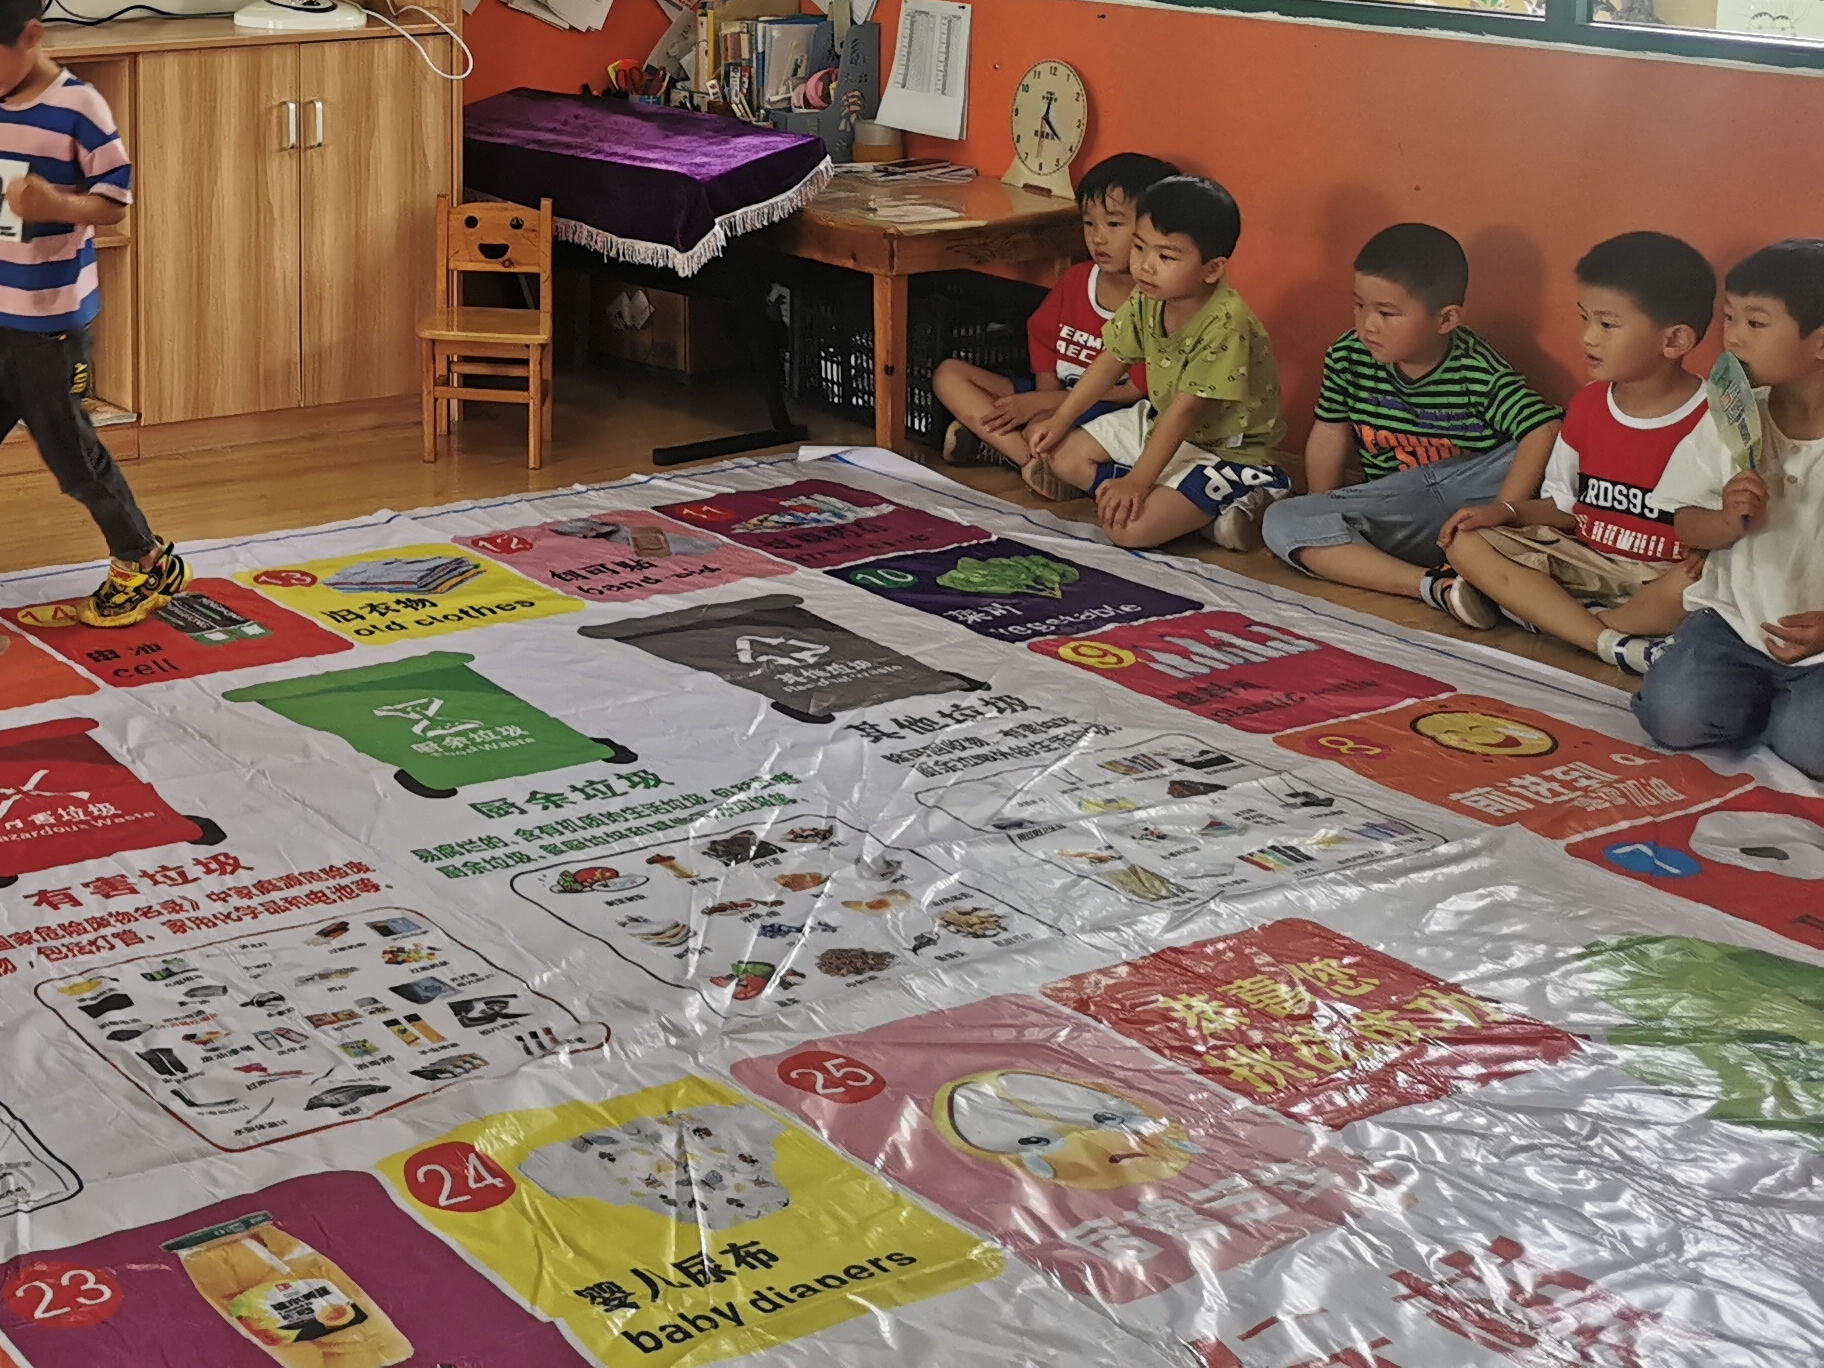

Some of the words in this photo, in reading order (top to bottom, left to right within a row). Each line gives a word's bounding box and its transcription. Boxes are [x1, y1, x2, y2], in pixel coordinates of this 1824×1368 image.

[682, 505, 724, 519] 11
[478, 535, 524, 551] 12
[258, 572, 312, 585] 13
[856, 569, 914, 586] 10
[21, 606, 76, 623] 14
[321, 597, 438, 624] 旧衣物
[353, 619, 409, 637] old
[415, 598, 535, 627] clothes
[113, 658, 180, 679] cell
[1072, 643, 1125, 666] 9
[844, 694, 1042, 744] 其他垃圾
[411, 724, 529, 754] 厨余垃圾
[1318, 736, 1383, 756] 8
[469, 768, 675, 820] 厨余垃圾
[91, 810, 156, 830] Waste
[1613, 842, 1681, 875] 7
[23, 852, 255, 911] 有害垃圾
[788, 1058, 875, 1096] 25
[417, 1152, 506, 1210] 24
[15, 1267, 113, 1323] 23
[622, 1305, 742, 1357] baby
